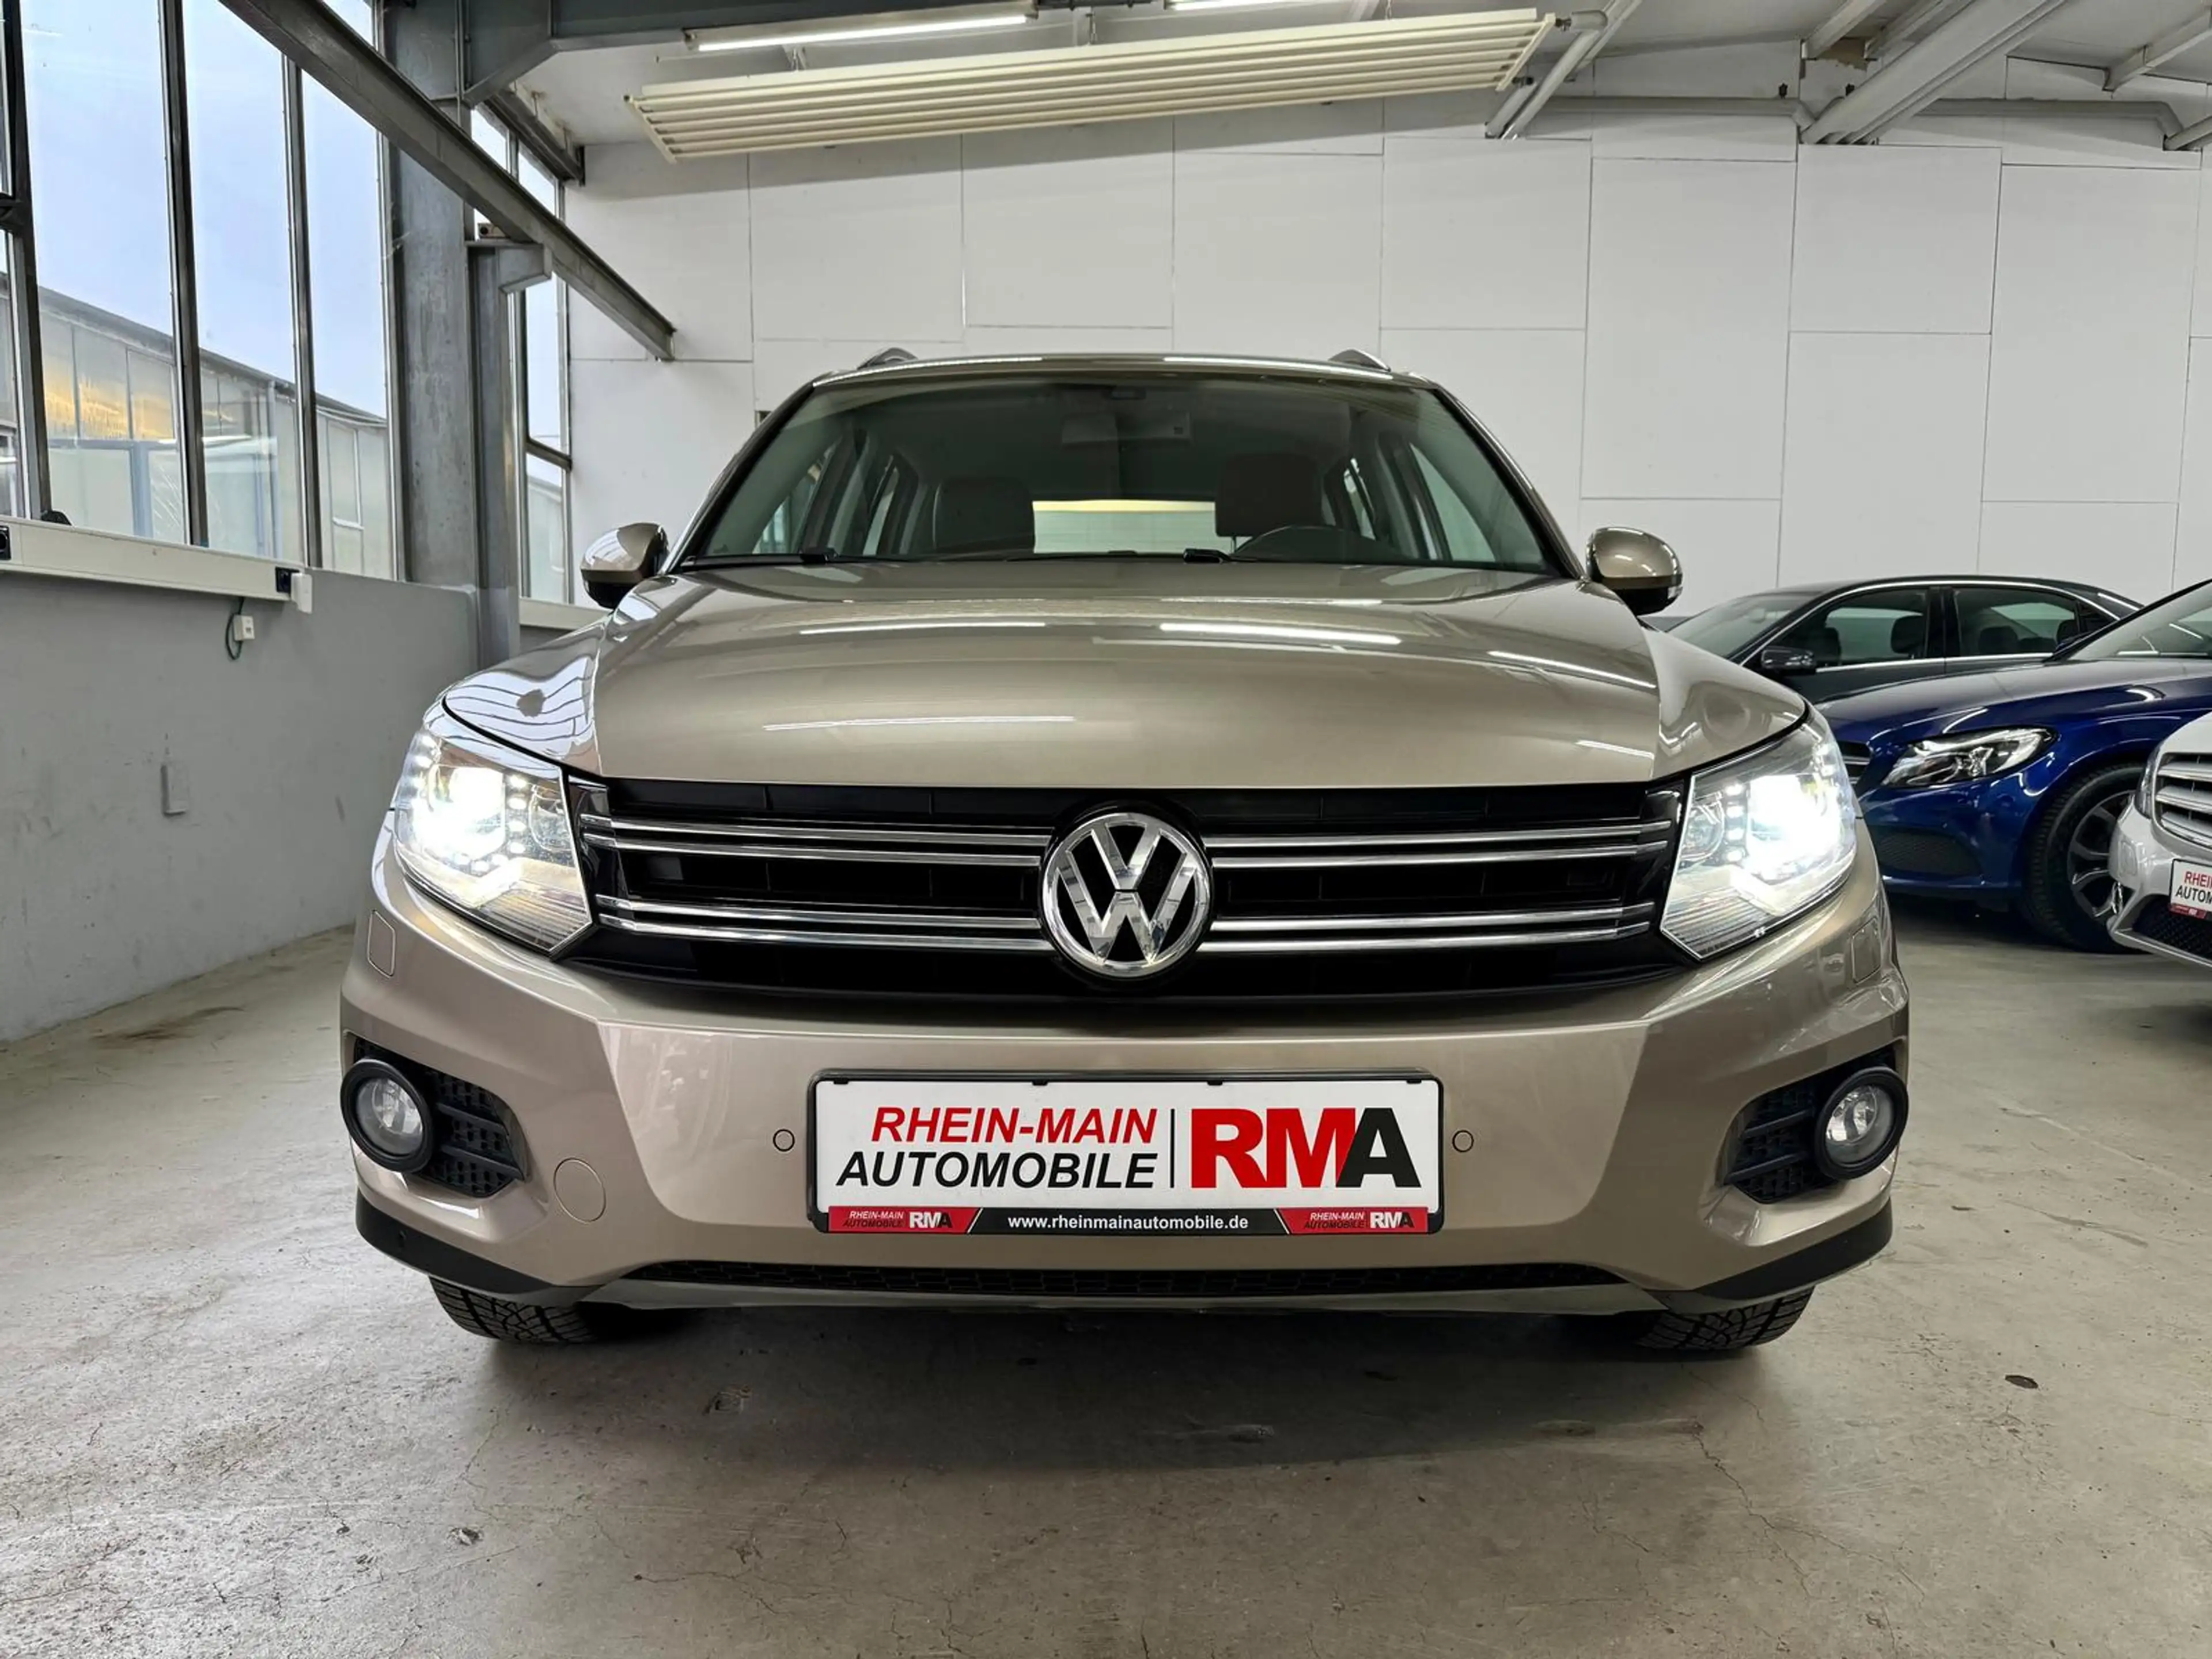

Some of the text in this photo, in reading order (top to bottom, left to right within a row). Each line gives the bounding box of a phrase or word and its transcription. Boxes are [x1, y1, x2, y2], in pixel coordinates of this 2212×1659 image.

[2184, 871, 2212, 888] RHEI
[871, 1106, 1158, 1144] RHEIN-MAIN
[1191, 1107, 1422, 1188] RMA
[835, 1151, 1158, 1188] AUTOMOBILE
[849, 1210, 904, 1219] RHEIN-MAIN
[909, 1211, 953, 1229] RMA
[1007, 1215, 1249, 1229] www.rheinmainautomobile.de
[1310, 1212, 1365, 1220] RHEIN-MAIN
[1370, 1211, 1415, 1229] RMA
